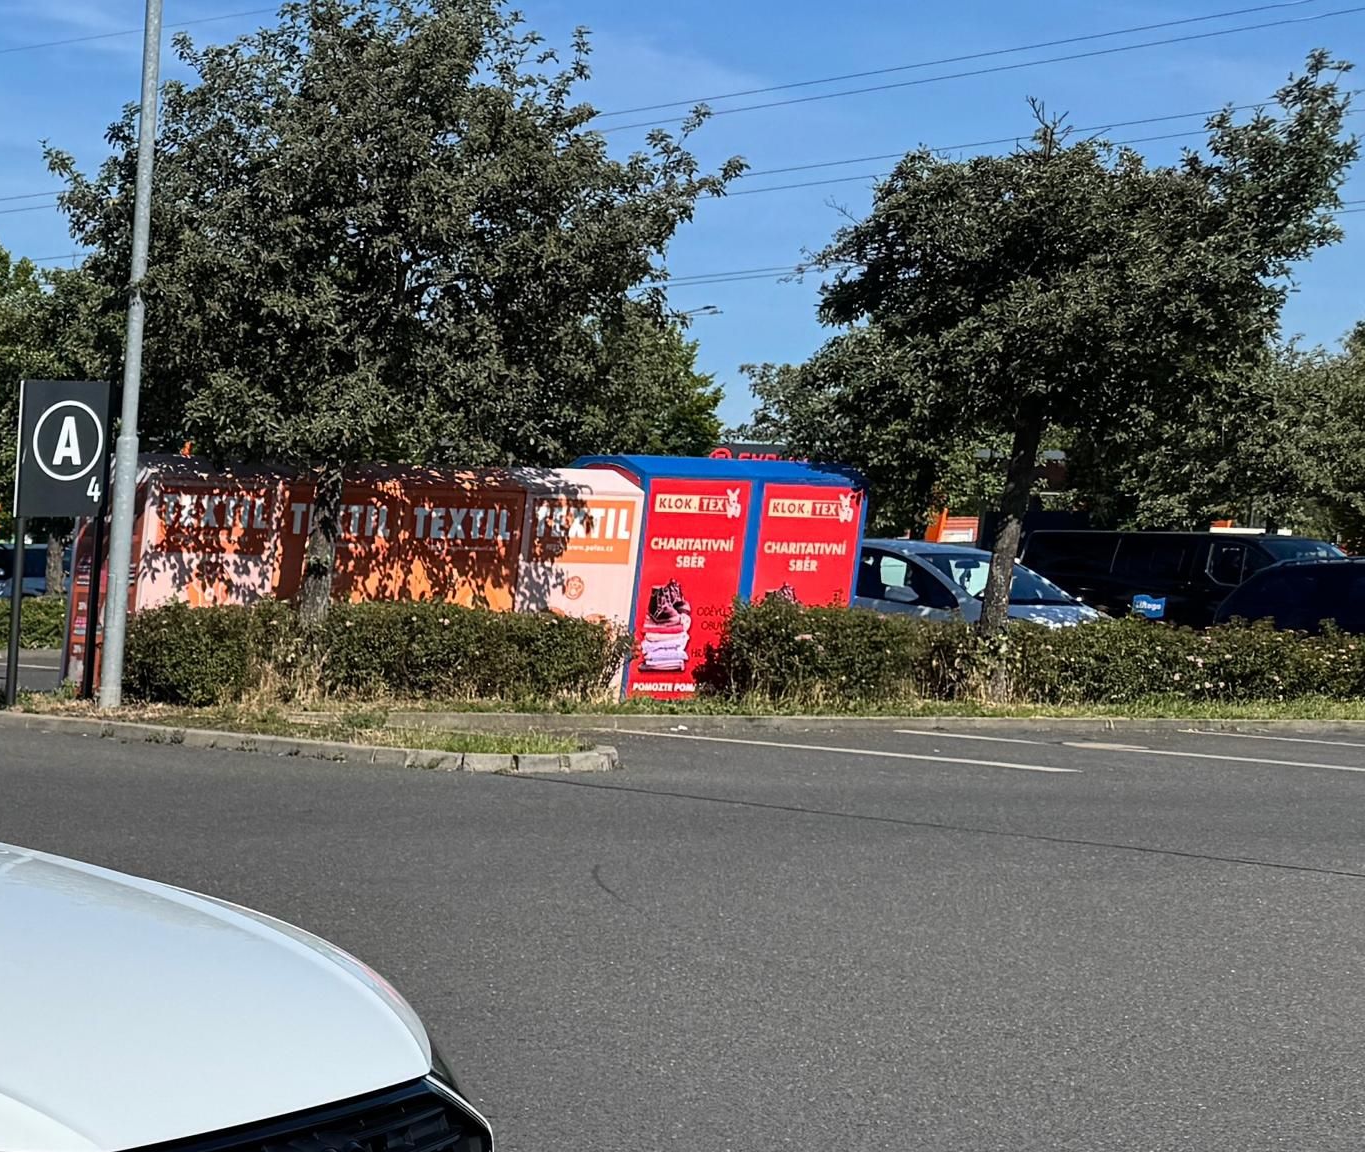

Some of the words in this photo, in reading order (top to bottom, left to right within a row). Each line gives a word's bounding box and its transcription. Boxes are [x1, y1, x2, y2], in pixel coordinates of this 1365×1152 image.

[52, 416, 81, 465] A
[86, 476, 101, 502] 4
[701, 500, 724, 511] TEX
[814, 504, 837, 517] TEX
[291, 503, 390, 537] TTIL
[414, 507, 510, 541] TEXTIL
[535, 505, 631, 540] TEXTIL
[651, 536, 734, 552] CHARITATIVNÍ
[764, 540, 846, 556] CHARITATIVNÍ
[675, 554, 705, 569] SBĚR
[788, 557, 817, 572] SBĚR
